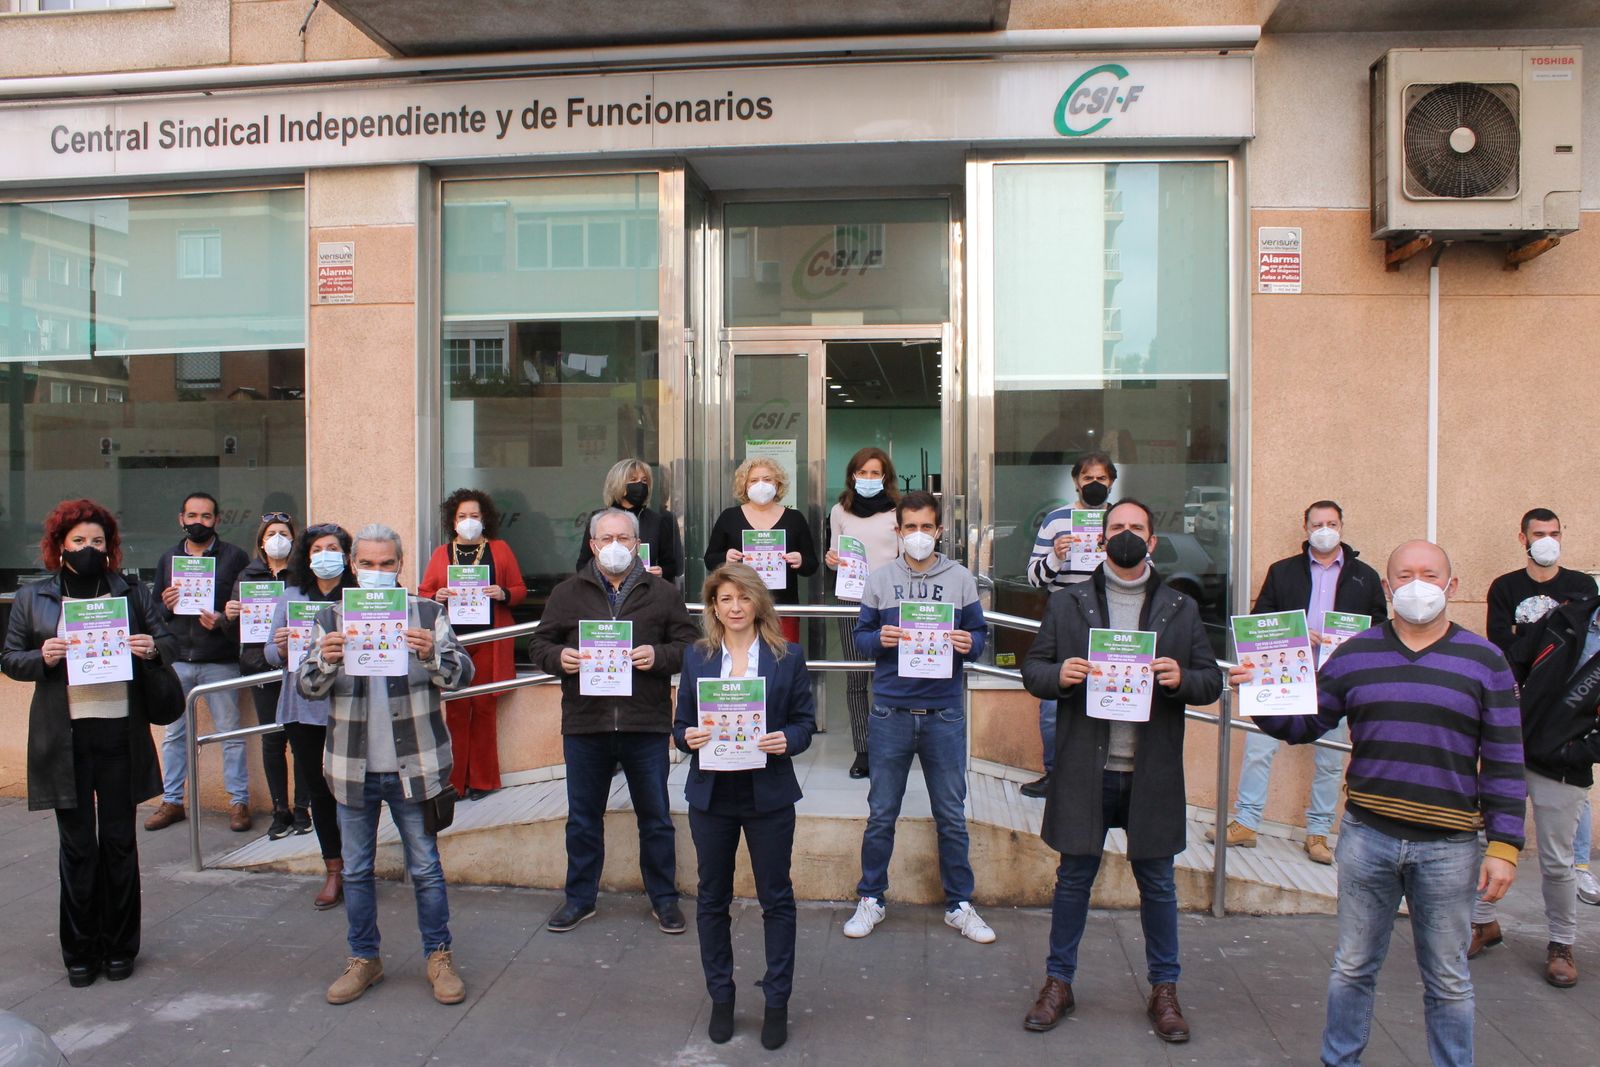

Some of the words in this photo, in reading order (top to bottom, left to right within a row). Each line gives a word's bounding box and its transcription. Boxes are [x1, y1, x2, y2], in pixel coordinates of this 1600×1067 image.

[1530, 57, 1575, 65] TOSHIBA
[50, 122, 148, 154] Central
[158, 115, 269, 149] Sindical
[279, 104, 486, 146] Independiente
[496, 108, 513, 139] y
[521, 100, 557, 130] de
[567, 91, 774, 128] Funcionarios
[1261, 254, 1299, 264] Alarma
[320, 267, 353, 276] Alarma
[366, 592, 384, 600] 8M
[893, 582, 943, 601] RIDE
[86, 602, 104, 610] 8M
[1257, 618, 1278, 628] 8M
[1113, 634, 1132, 642] 8M
